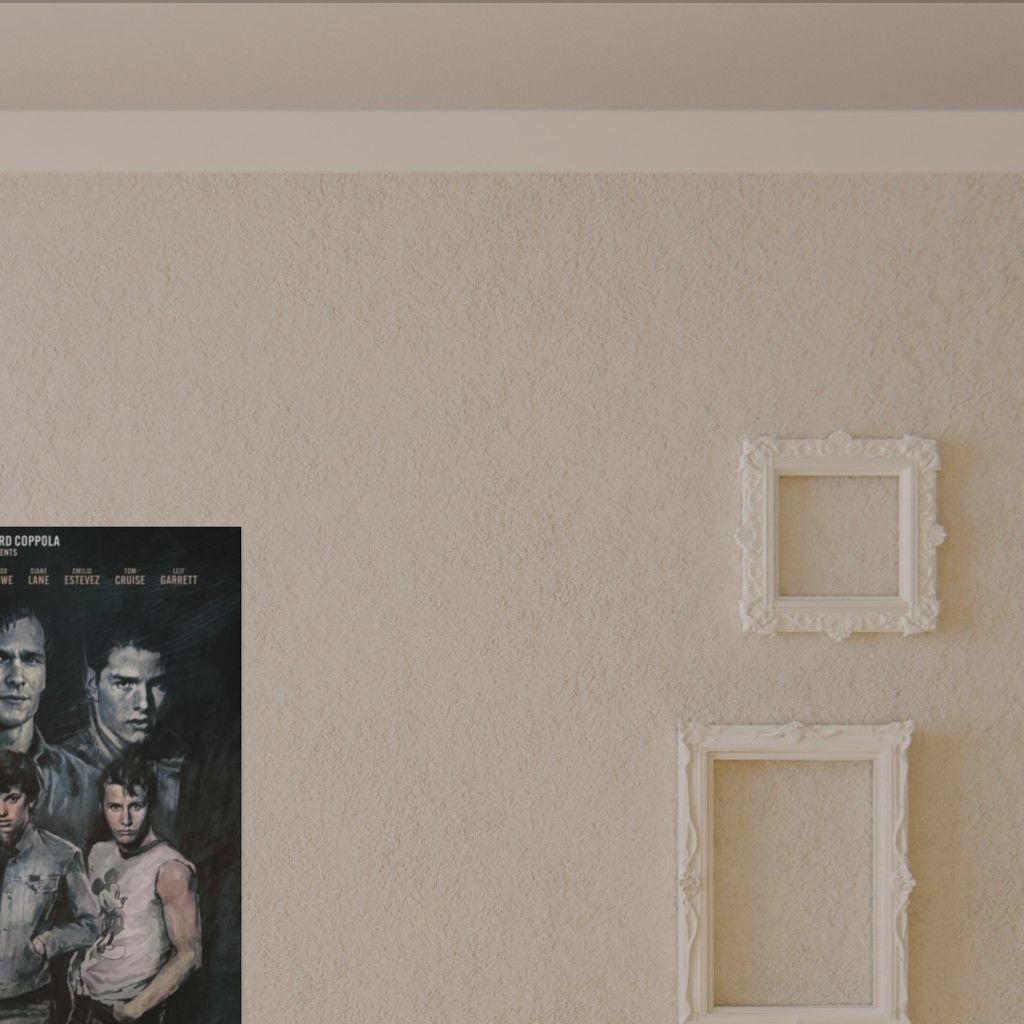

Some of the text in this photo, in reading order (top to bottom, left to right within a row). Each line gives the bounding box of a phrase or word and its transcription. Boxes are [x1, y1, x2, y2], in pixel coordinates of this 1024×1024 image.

[15, 534, 60, 547] COPPOLA
[30, 567, 48, 575] DIANE
[28, 575, 49, 585] LANE
[64, 575, 100, 585] ESTEVEZ
[115, 575, 145, 585] CRUISE
[160, 575, 198, 585] GARRETT
